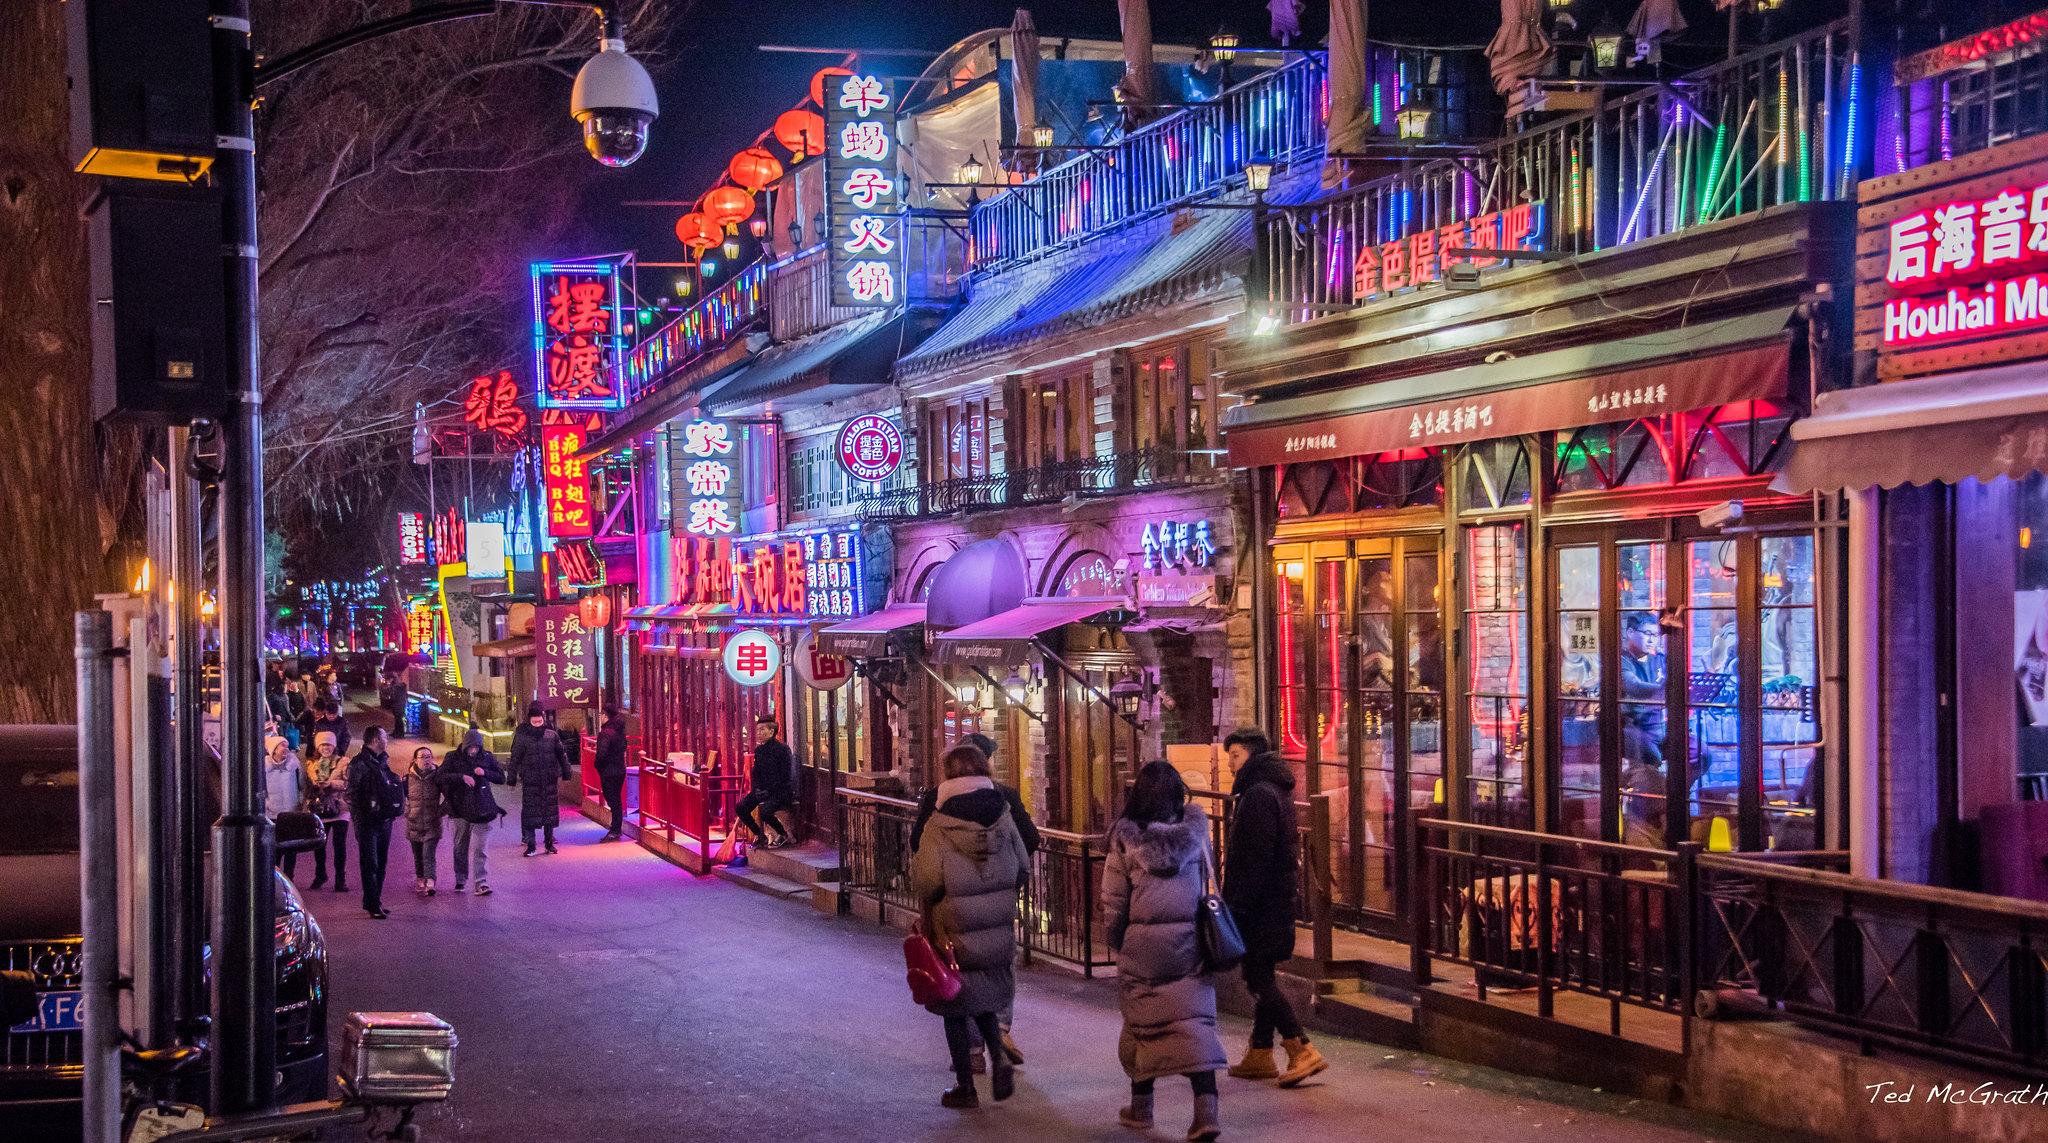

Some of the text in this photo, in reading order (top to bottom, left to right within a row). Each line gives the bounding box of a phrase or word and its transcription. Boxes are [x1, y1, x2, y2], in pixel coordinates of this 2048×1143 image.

[1354, 203, 1536, 298] 金色提香酒吧
[548, 276, 612, 399] 摆渡
[1885, 281, 1995, 342] Houhai
[844, 419, 900, 454] GOLDEN TITIAN
[1408, 405, 1494, 439] 金色提香酒吧
[548, 440, 565, 524] BBQ BAR
[561, 432, 589, 527] 疯狂翅吧
[683, 421, 737, 535] 家常菜
[851, 462, 893, 478] COFFEE
[731, 540, 806, 615] 大碗居
[1141, 519, 1217, 570] 金色提香
[545, 619, 559, 698] BBQ BAR
[561, 613, 589, 704] 疯狂翅吧
[736, 642, 768, 677] 串
